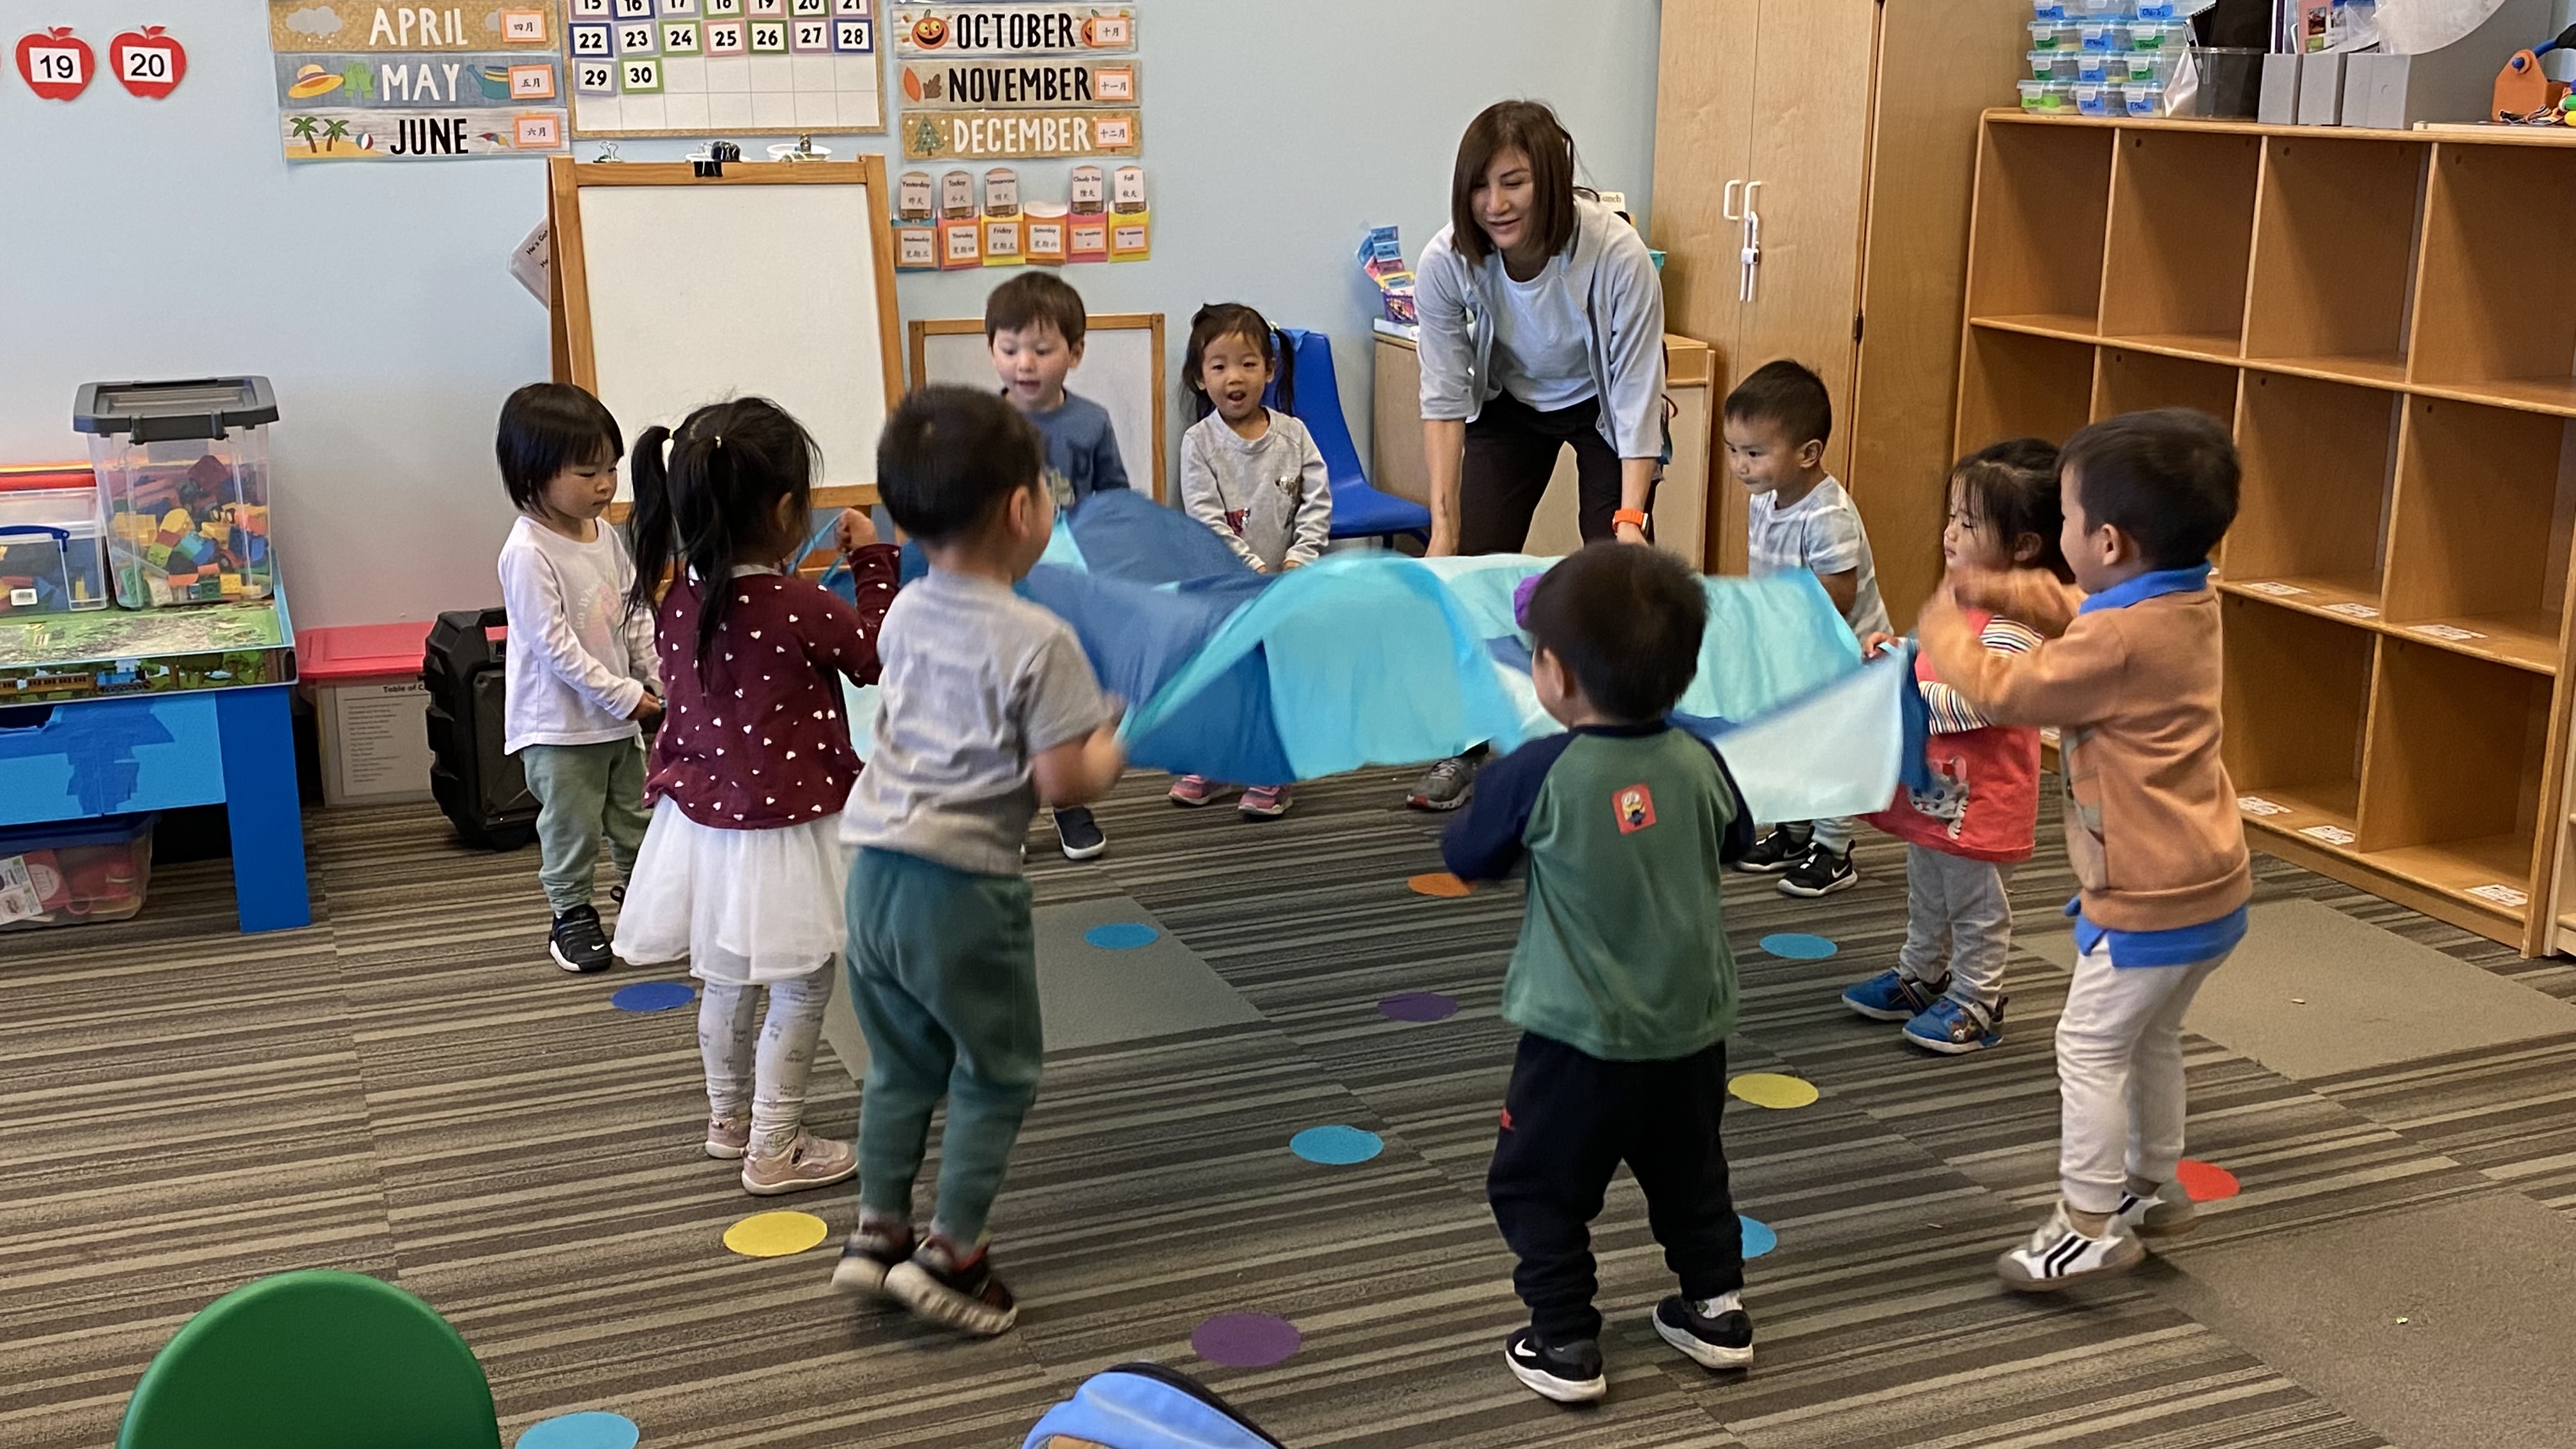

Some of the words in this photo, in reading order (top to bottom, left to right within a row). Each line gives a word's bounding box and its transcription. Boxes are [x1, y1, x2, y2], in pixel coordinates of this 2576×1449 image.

[368, 8, 468, 47] APRIL
[513, 20, 534, 33] 四月
[956, 13, 1076, 49] OCTOBER
[1102, 27, 1120, 38] 十月
[578, 33, 602, 49] 22
[625, 30, 648, 47] 23
[670, 29, 692, 46] 24
[714, 30, 737, 47] 25
[756, 29, 778, 45] 26
[801, 27, 822, 44] 27
[843, 28, 864, 45] 28
[39, 54, 73, 79] 19
[130, 52, 165, 77] 20
[382, 64, 460, 102] MAY
[521, 76, 541, 88] 五月
[585, 69, 608, 86] 29
[629, 66, 652, 84] 30
[948, 66, 1092, 103] NOVEMBER
[1101, 80, 1127, 92] 十一月
[390, 118, 469, 155] JUNE
[526, 126, 547, 137] 六月
[953, 117, 1092, 154] DECEMBER
[1100, 128, 1126, 139] 十二月
[902, 181, 930, 189] Yesterday
[383, 685, 406, 693] Table
